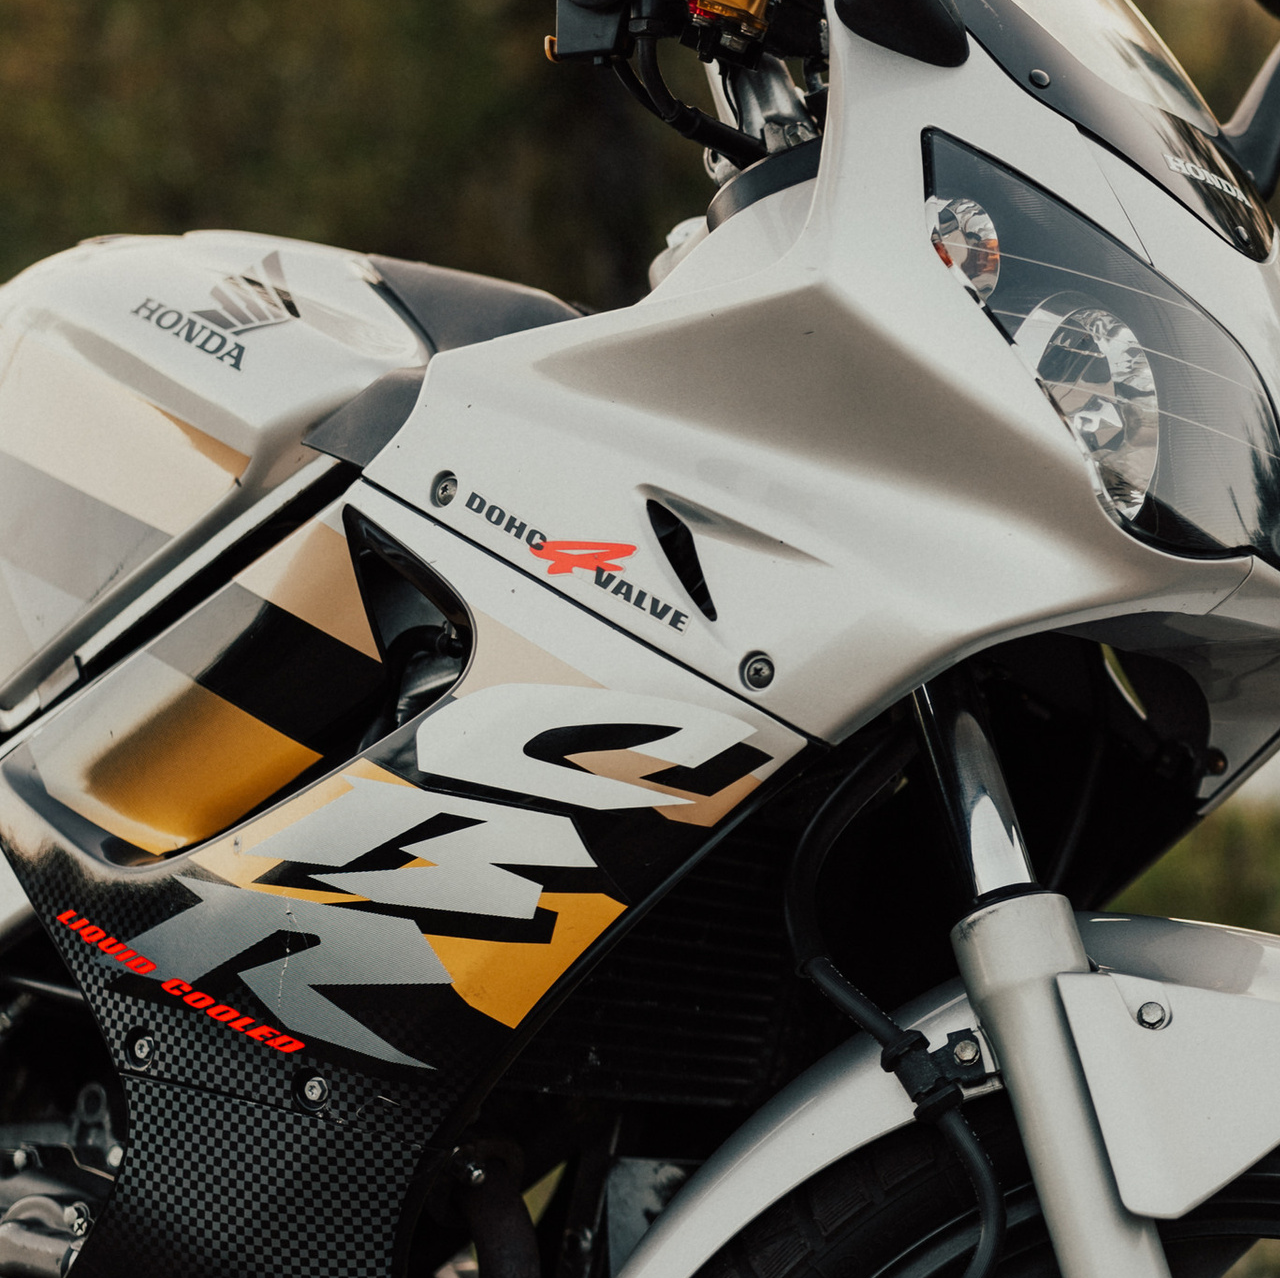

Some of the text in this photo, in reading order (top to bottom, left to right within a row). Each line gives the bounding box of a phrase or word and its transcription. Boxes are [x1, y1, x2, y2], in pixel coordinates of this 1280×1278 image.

[1162, 153, 1252, 208] HONDA
[130, 298, 244, 371] HONDA
[465, 491, 690, 633] DOHC 4 VALVE
[56, 910, 306, 1054] LIQUID COOLED
